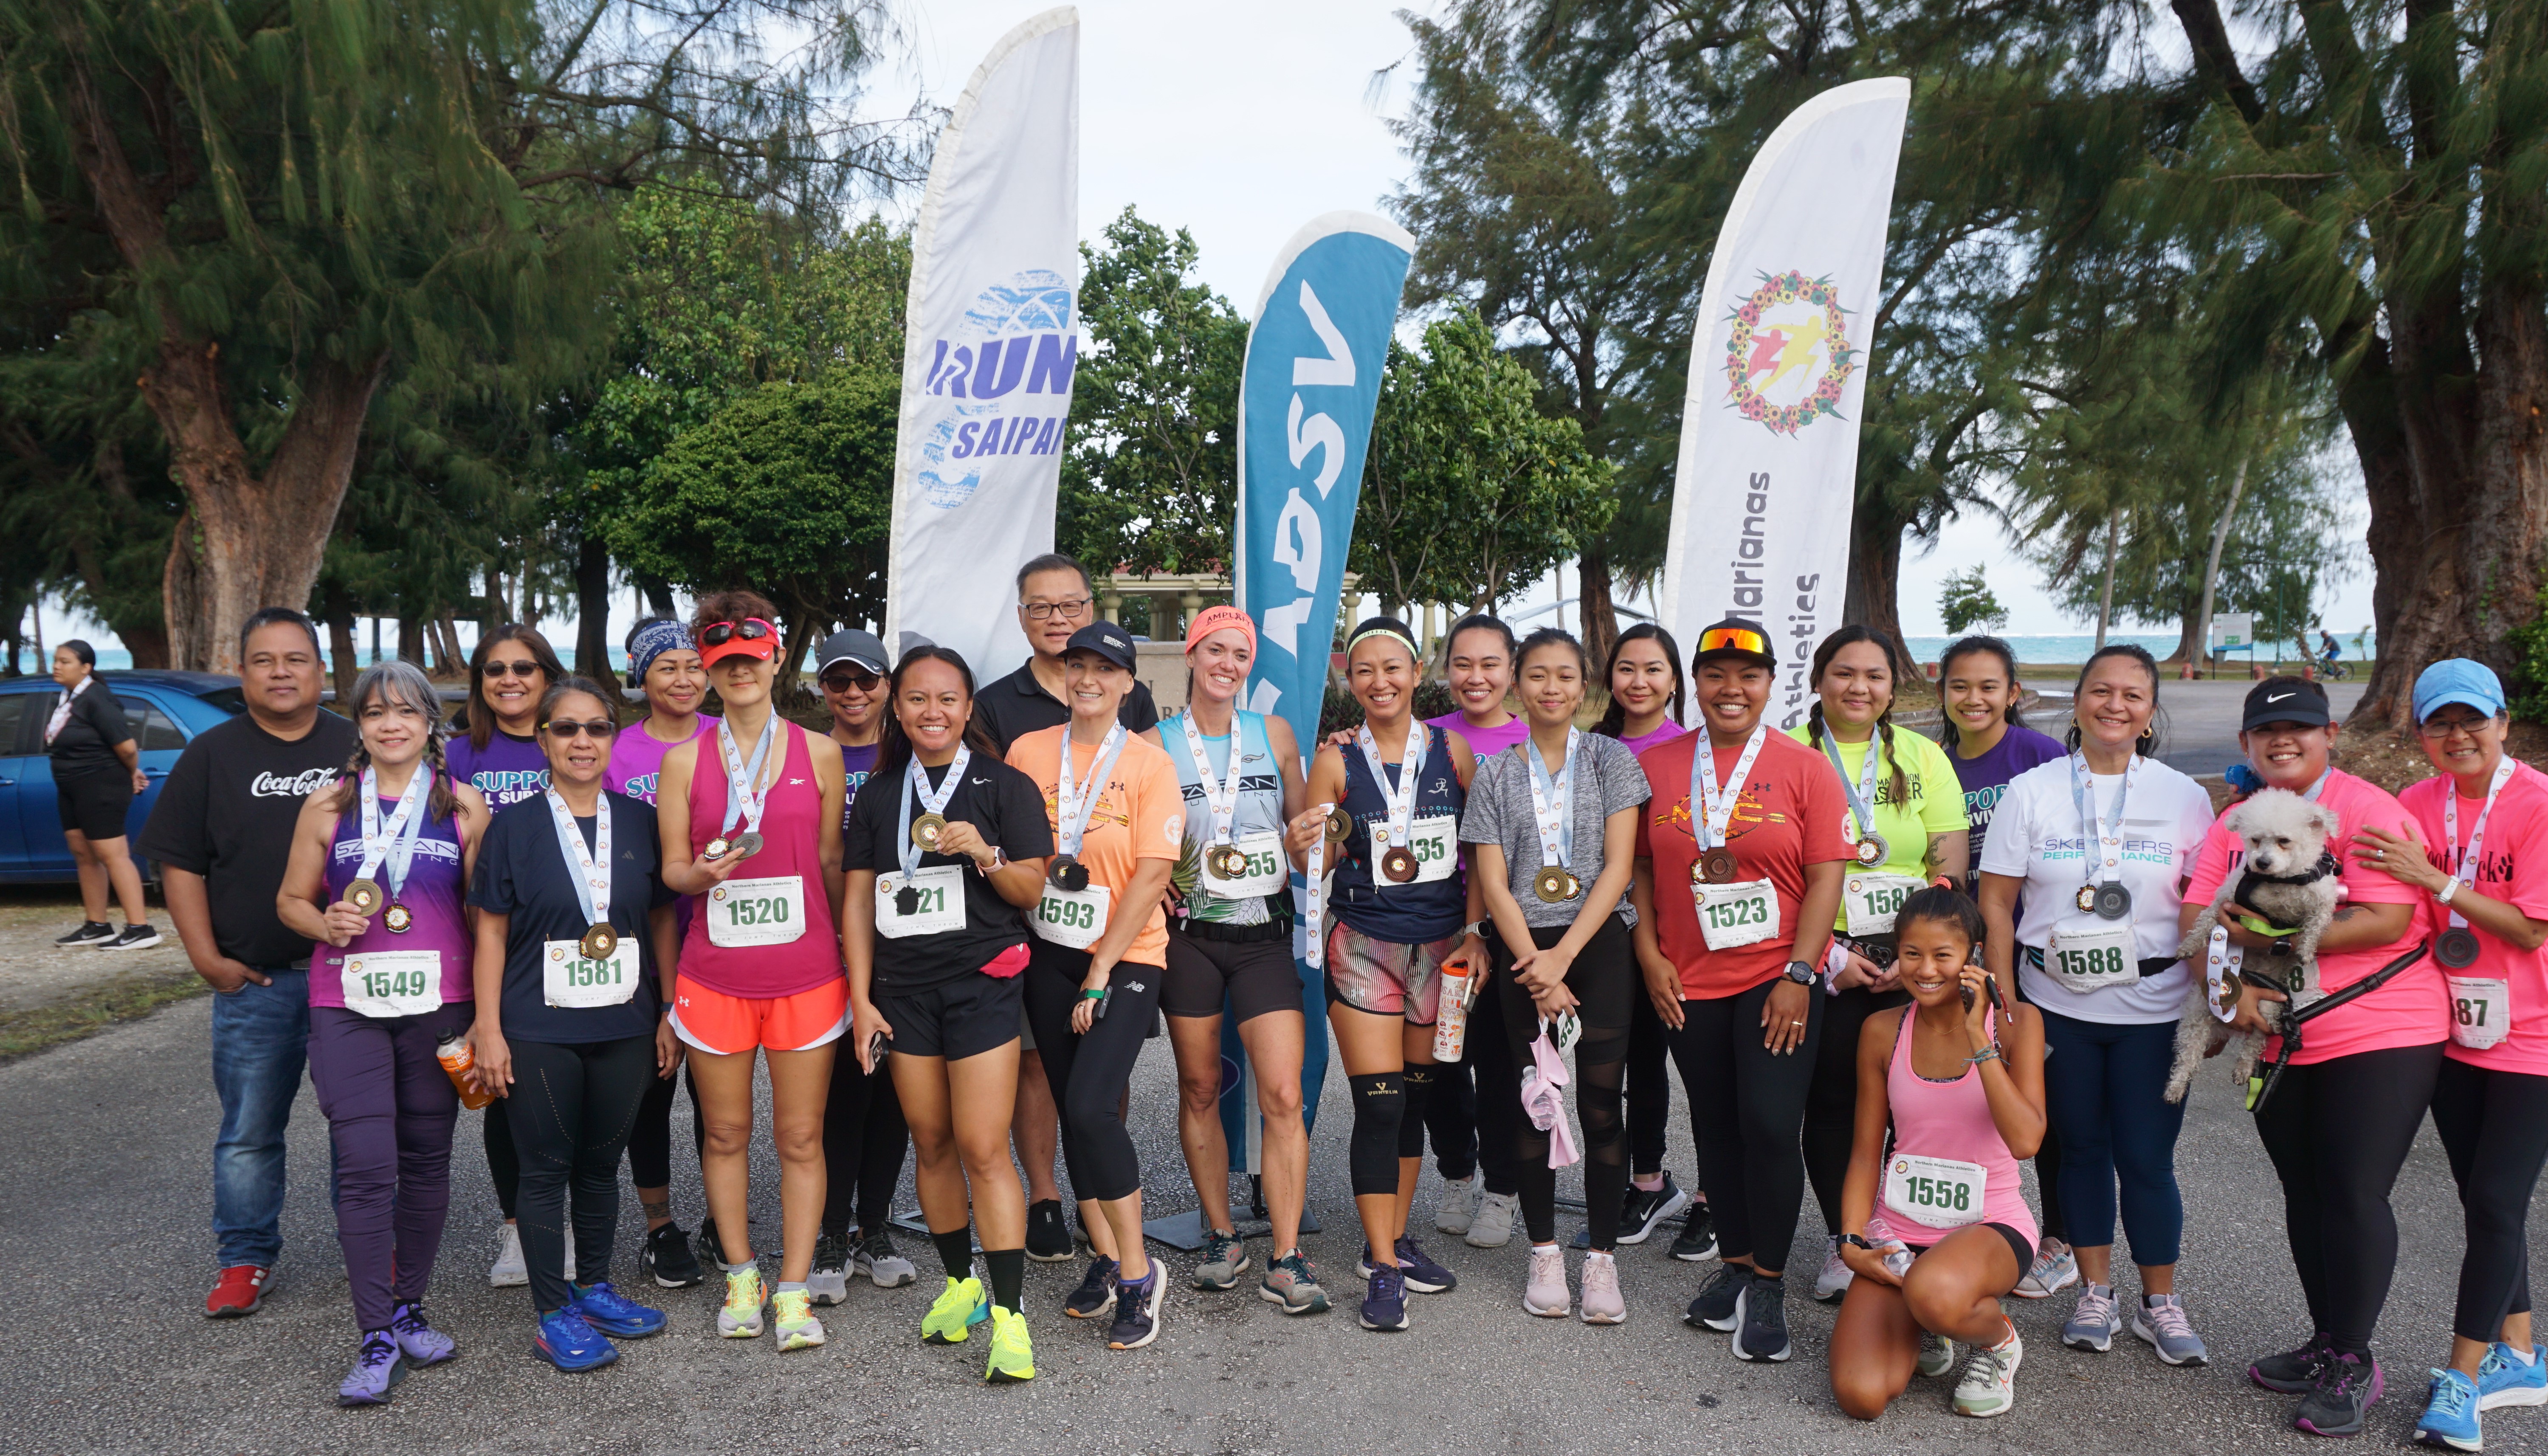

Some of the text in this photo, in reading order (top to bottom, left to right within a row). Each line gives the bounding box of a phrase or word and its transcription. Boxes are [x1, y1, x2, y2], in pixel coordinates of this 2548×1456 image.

[926, 334, 1077, 400] RUN
[499, 790, 539, 804] SUR
[337, 853, 458, 866] RUING
[2045, 838, 2172, 855] SKEERS
[1232, 851, 1277, 879] 55
[726, 897, 789, 926] 1520
[893, 886, 944, 917] 21
[1039, 897, 1095, 929] 1593
[1705, 897, 1767, 929] 1523
[564, 958, 622, 987] 1581
[2056, 946, 2123, 974] 1588
[361, 971, 426, 997] 1549
[1905, 1176, 1970, 1211] 1558
